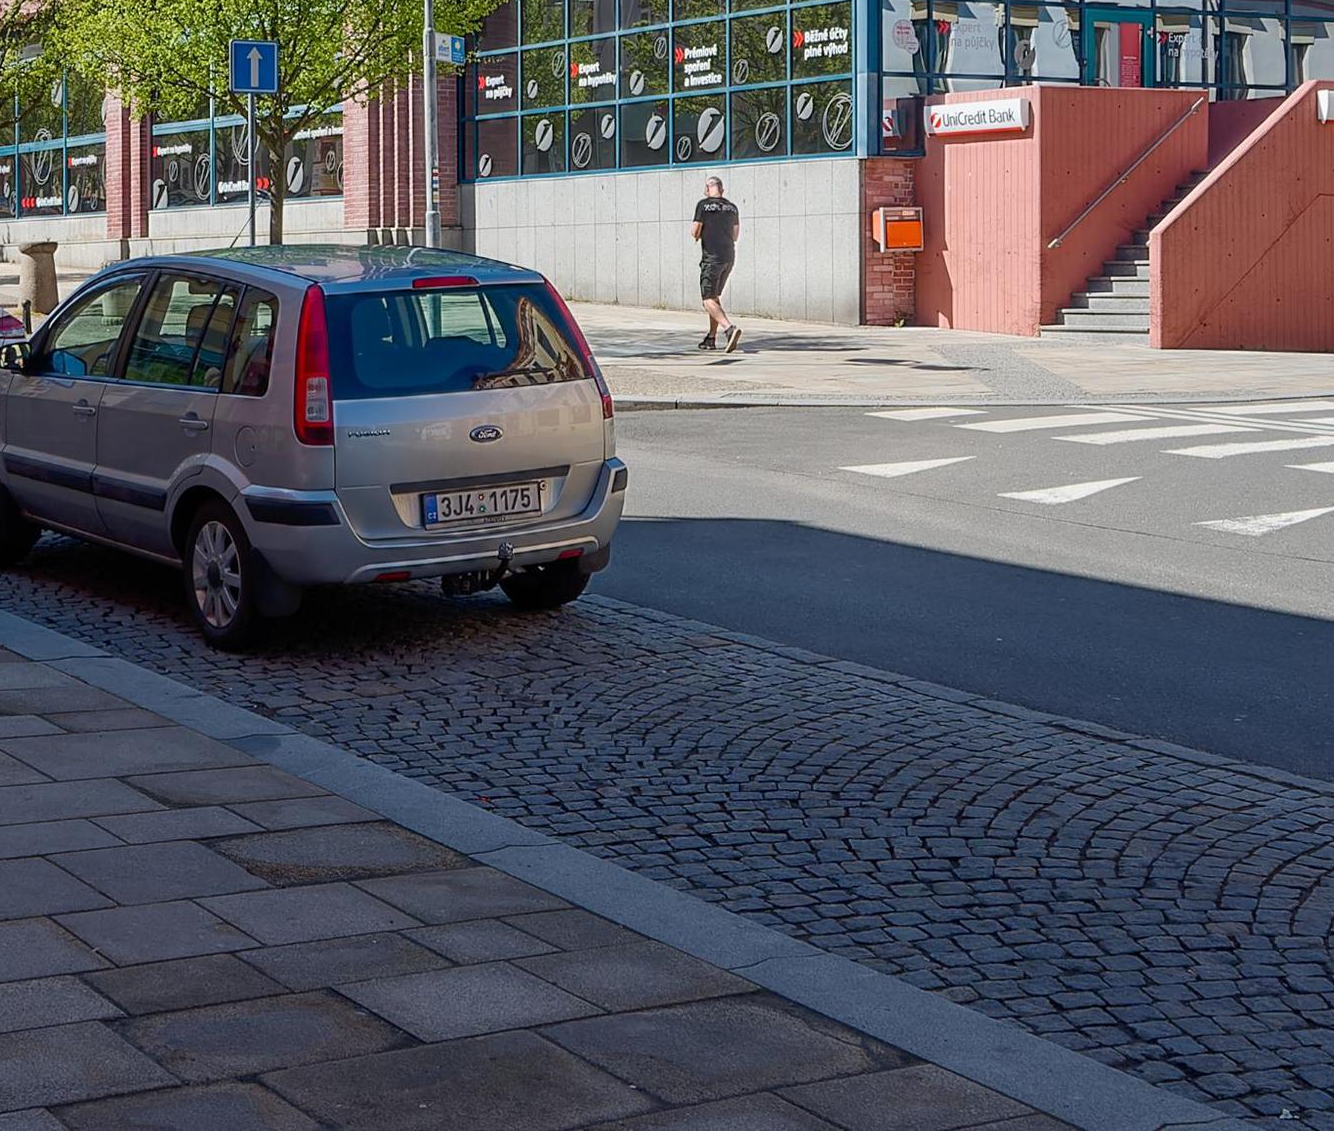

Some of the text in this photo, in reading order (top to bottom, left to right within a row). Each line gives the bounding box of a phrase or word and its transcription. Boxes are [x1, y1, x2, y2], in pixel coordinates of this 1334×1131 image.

[803, 27, 829, 43] Běžné
[964, 35, 995, 50] půjčky
[684, 44, 718, 59] Prémiové
[803, 41, 849, 61] plné výhod
[1168, 48, 1179, 58] na
[579, 61, 600, 75] Expert
[683, 58, 711, 75] spoření
[485, 74, 505, 88] Expert
[578, 77, 587, 87] na
[942, 107, 1016, 127] UniCredit Bank
[477, 429, 498, 440] Ford
[441, 488, 531, 518] 3J4 1175
